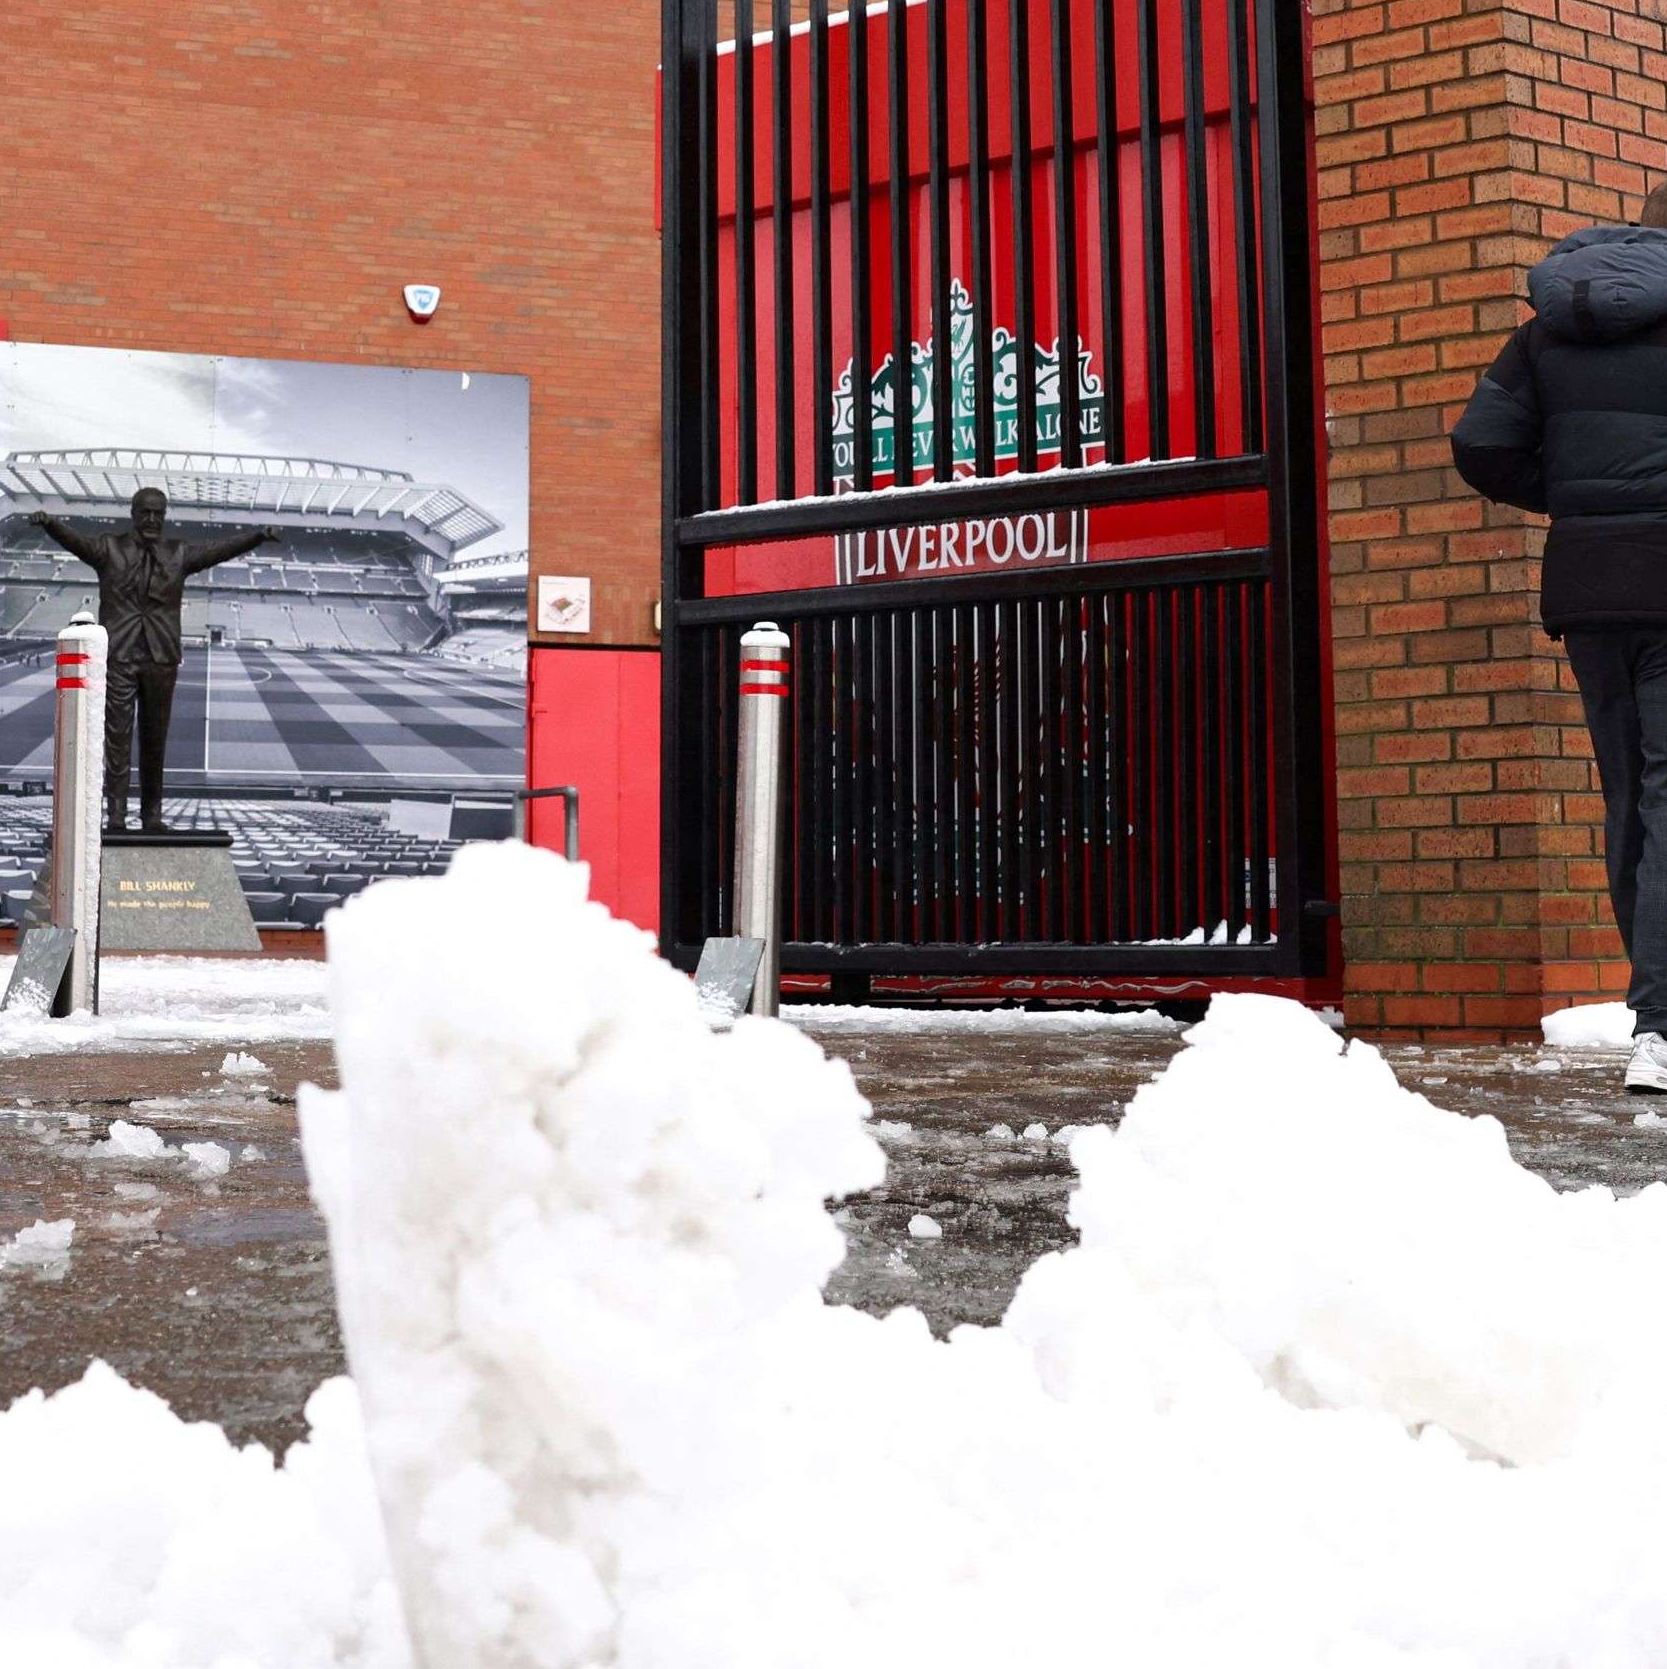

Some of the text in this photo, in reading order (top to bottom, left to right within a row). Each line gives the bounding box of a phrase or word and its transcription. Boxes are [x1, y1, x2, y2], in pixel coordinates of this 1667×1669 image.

[857, 510, 1068, 578] LIVERPOOL
[119, 880, 196, 892] BILL SHANKLY
